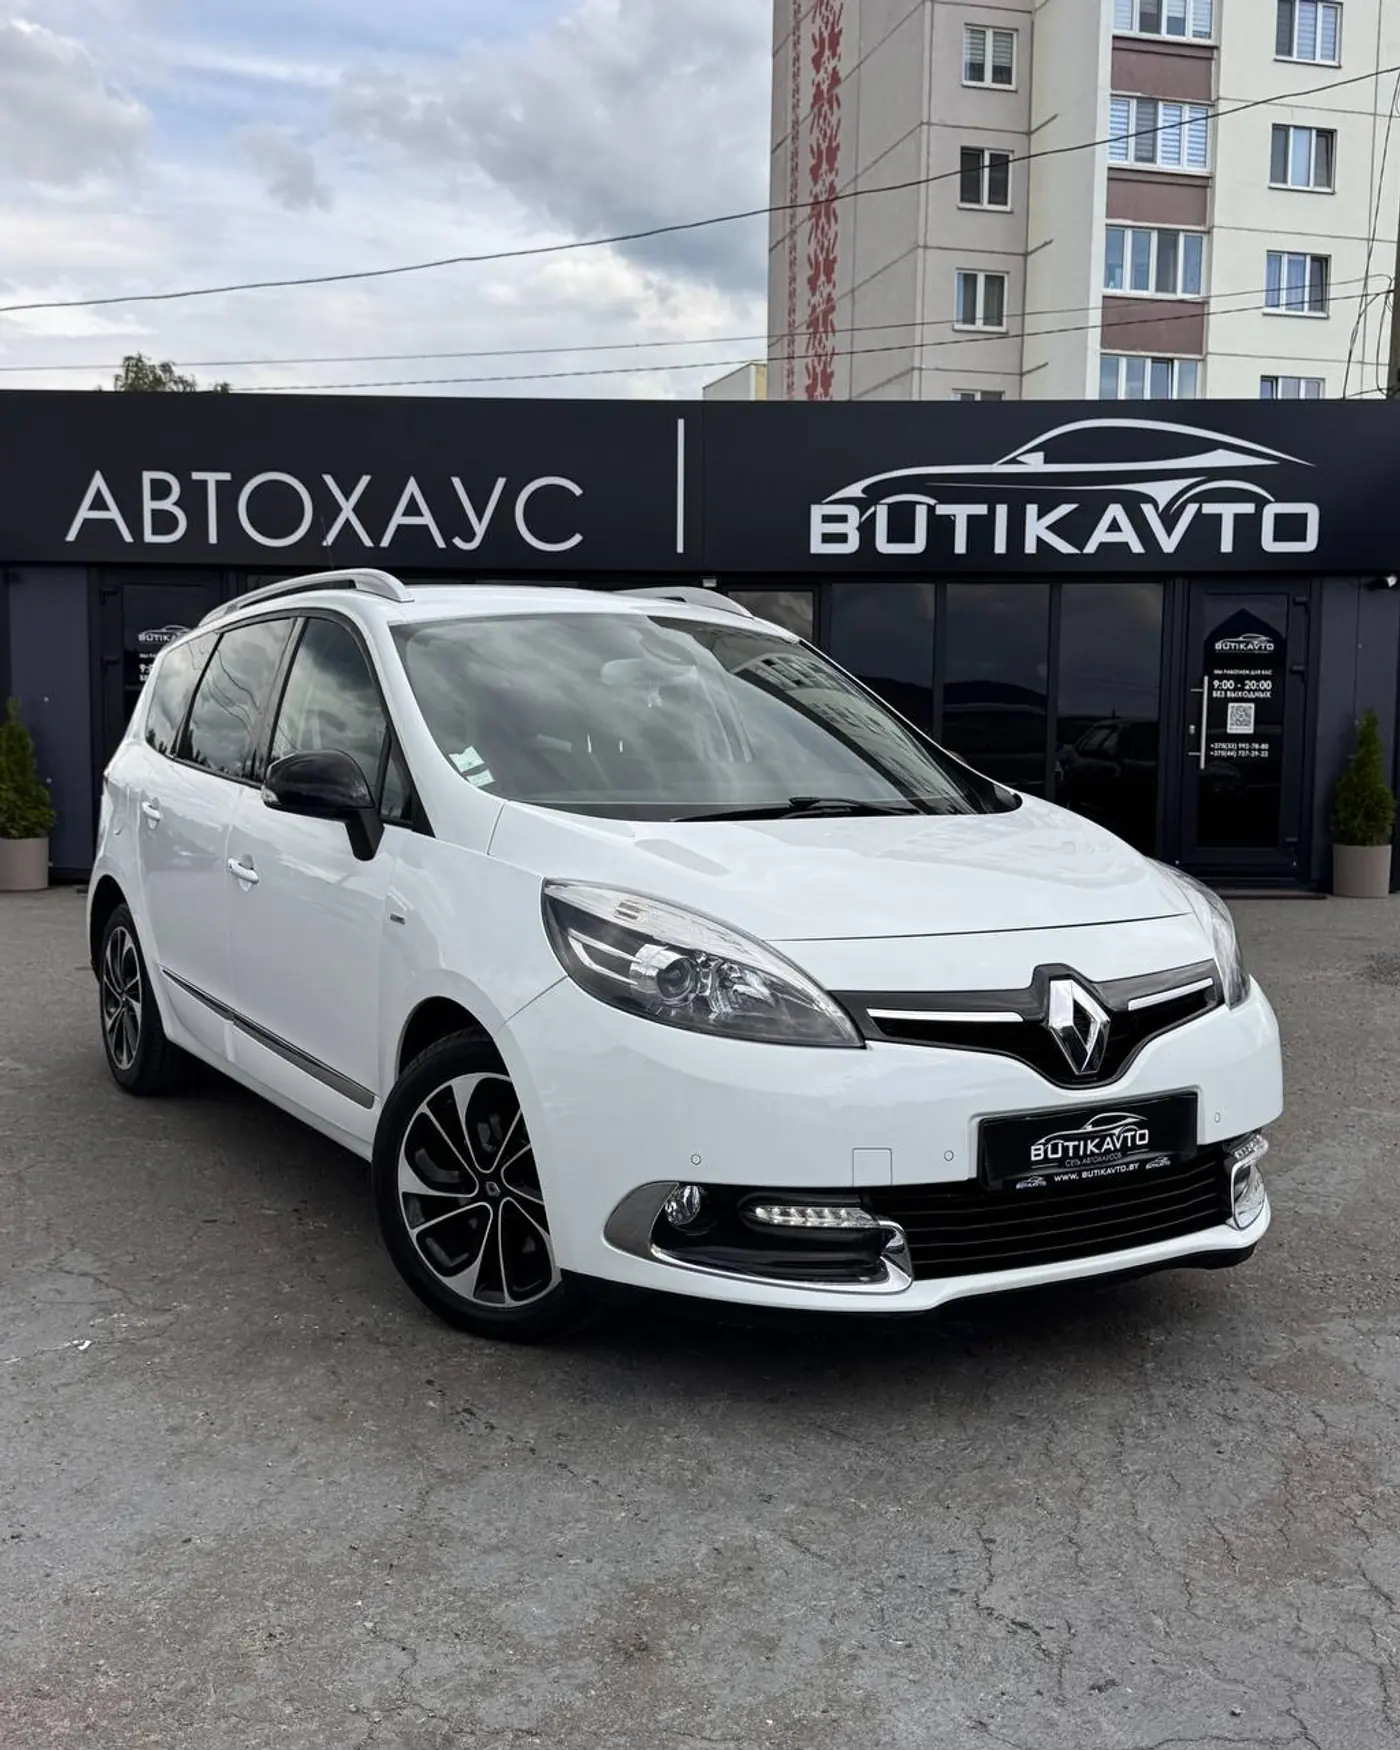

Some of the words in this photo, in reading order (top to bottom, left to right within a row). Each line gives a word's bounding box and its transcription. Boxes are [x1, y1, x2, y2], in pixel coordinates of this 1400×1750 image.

[65, 470, 585, 552] АВТОХАУС
[808, 502, 1321, 556] BUTIKAVTO
[1214, 642, 1275, 650] BUTIKAVTO
[1212, 680, 1235, 690] 9:00
[1244, 680, 1273, 691] 20:00
[1212, 690, 1225, 699] БЕЗ
[1226, 690, 1272, 699] ВЫХОДНЫХ
[1030, 1129, 1150, 1162] BUTIKAVTO
